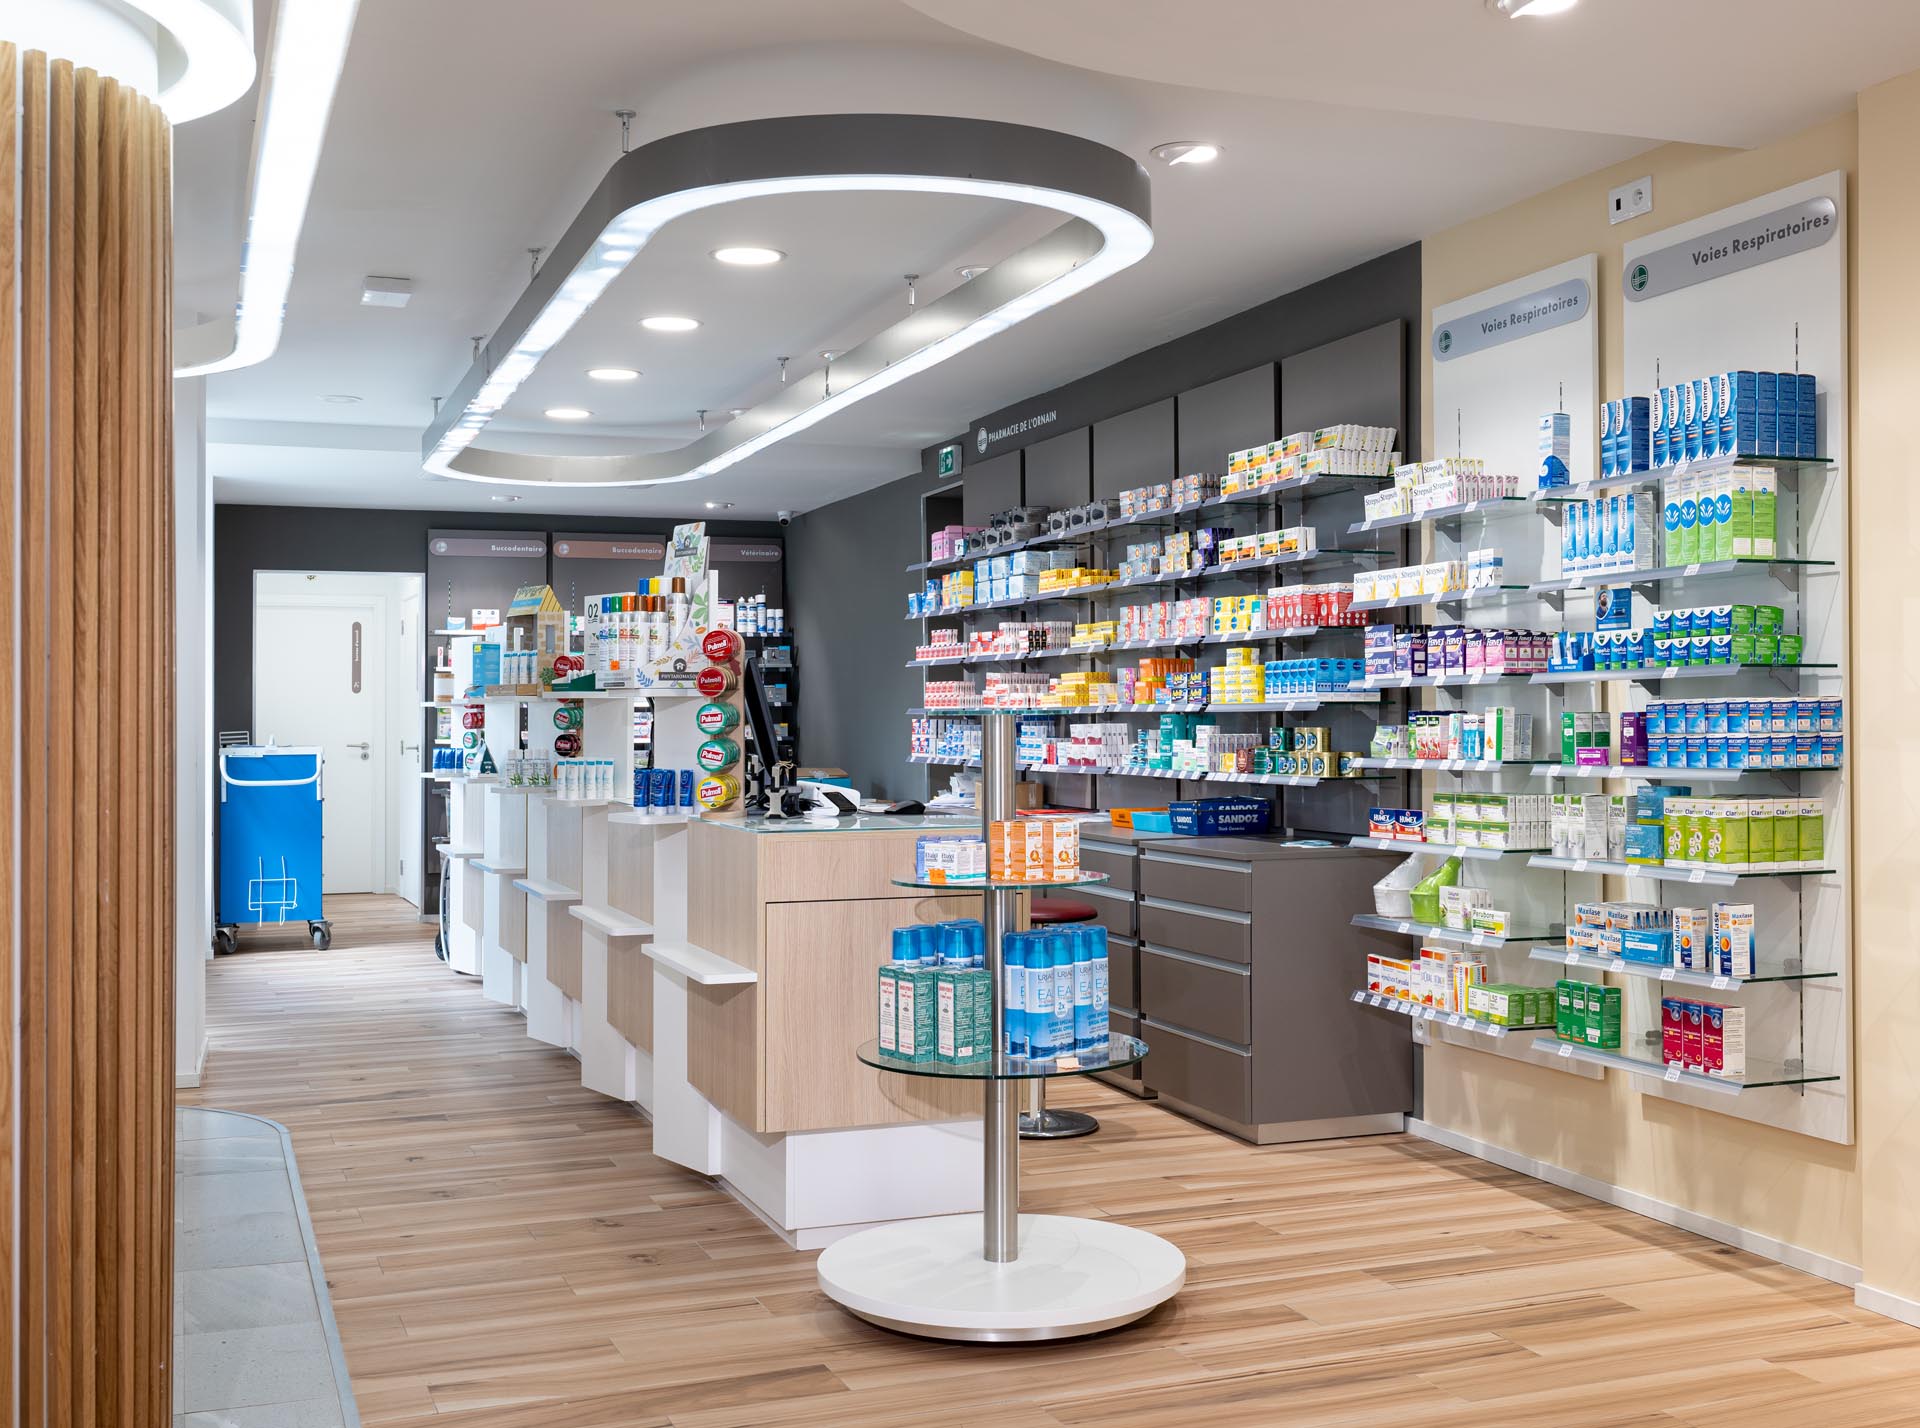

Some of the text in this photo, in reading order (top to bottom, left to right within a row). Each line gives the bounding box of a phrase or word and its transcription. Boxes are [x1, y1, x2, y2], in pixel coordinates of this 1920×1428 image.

[1692, 213, 1829, 266] Voies Respiratoires
[1481, 295, 1578, 335] Voies Respiratoires
[988, 410, 1057, 443] PHARMACIE DE L'ORNAIN
[491, 544, 544, 552] Buccodentaire
[612, 546, 662, 554] Buccodentaire
[587, 603, 598, 618] 02
[707, 639, 728, 651] Pulmoll
[700, 676, 722, 684] Pulmoll
[701, 715, 722, 723] Pulmoll
[702, 750, 722, 760] Pulmoll
[701, 787, 722, 798] Pulmoll
[1218, 814, 1258, 824] SANDOZ
[1399, 815, 1417, 823] HUMEX
[1577, 906, 1600, 916] Maxilase
[1607, 910, 1629, 920] Maxilase
[1569, 928, 1593, 939] Maxilase
[1600, 933, 1621, 943] Maxilase
[1057, 969, 1072, 978] URIA
[1080, 982, 1092, 992] EA
[1096, 978, 1108, 989] EA
[1038, 988, 1053, 1000] EA
[1057, 985, 1072, 997] EA
